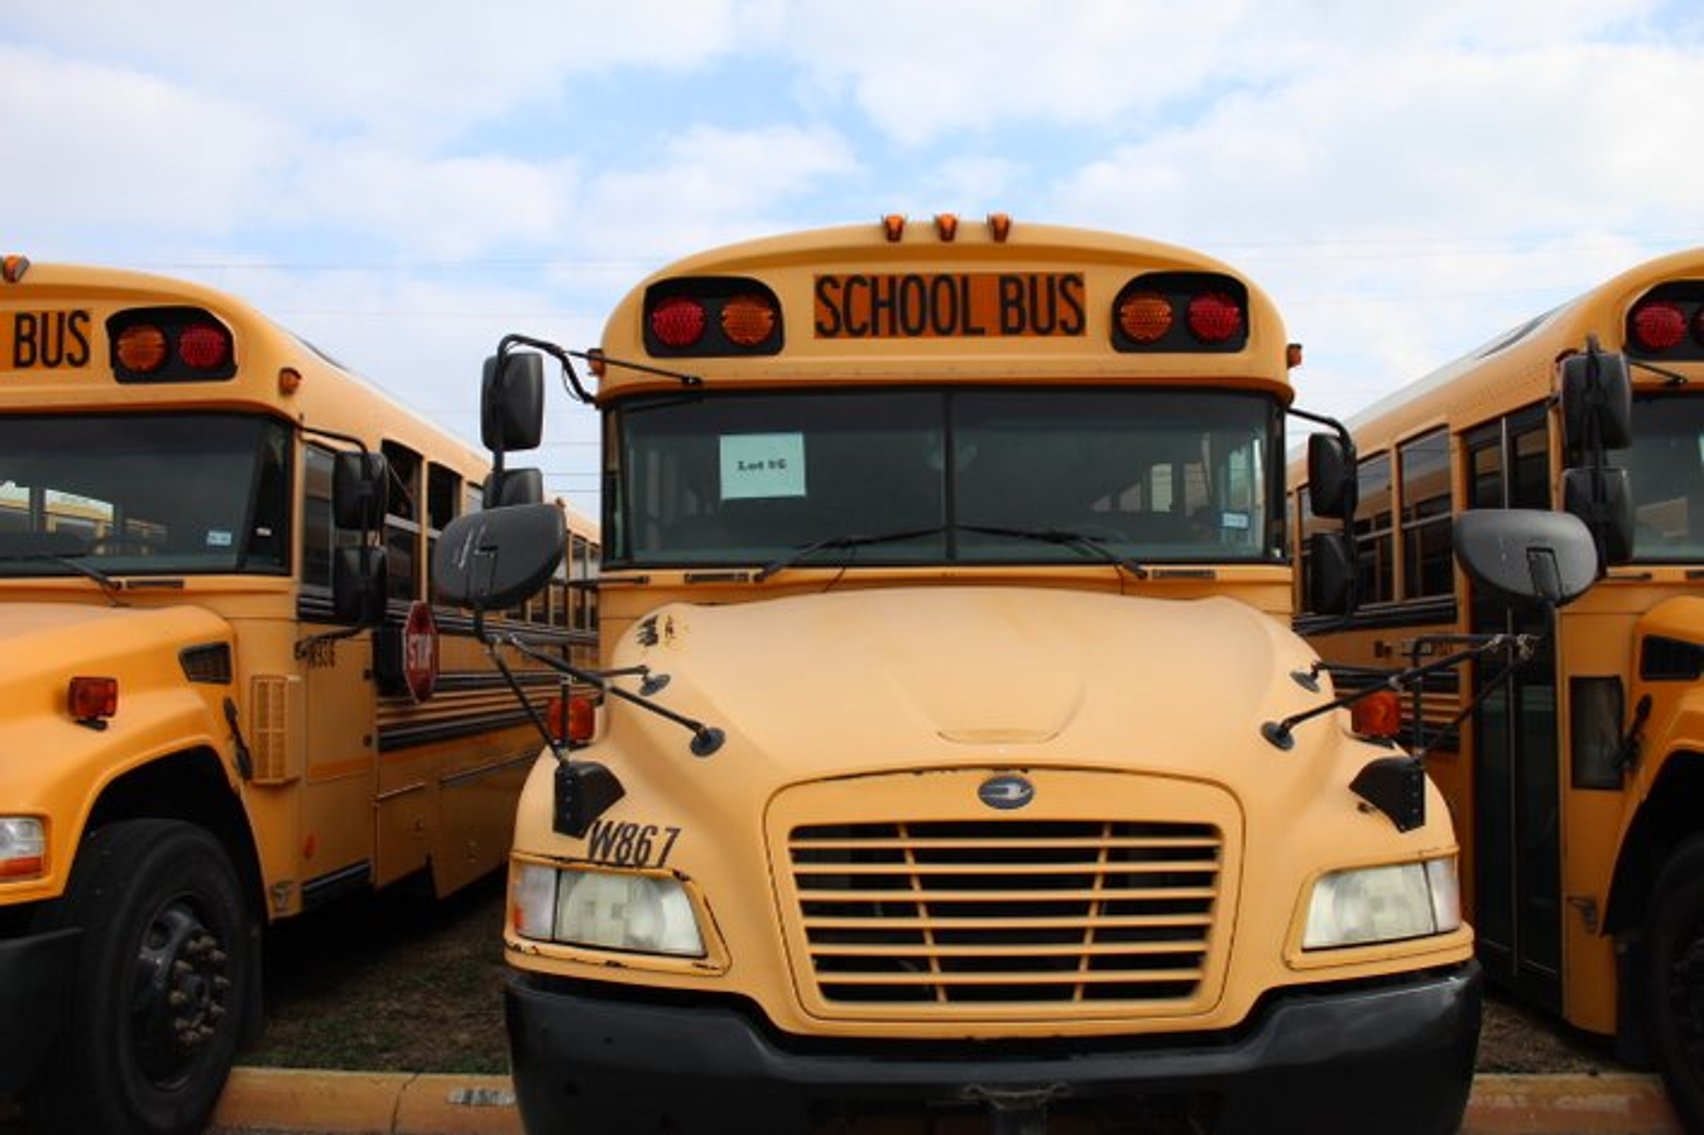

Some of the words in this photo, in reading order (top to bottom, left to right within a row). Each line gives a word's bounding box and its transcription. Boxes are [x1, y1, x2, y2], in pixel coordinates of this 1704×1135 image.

[815, 274, 986, 337] SCHOOL
[1000, 273, 1086, 336] BUS
[13, 309, 90, 368] BUS
[738, 460, 764, 471] Lot
[407, 632, 433, 670] STOP
[588, 820, 681, 868] W867
